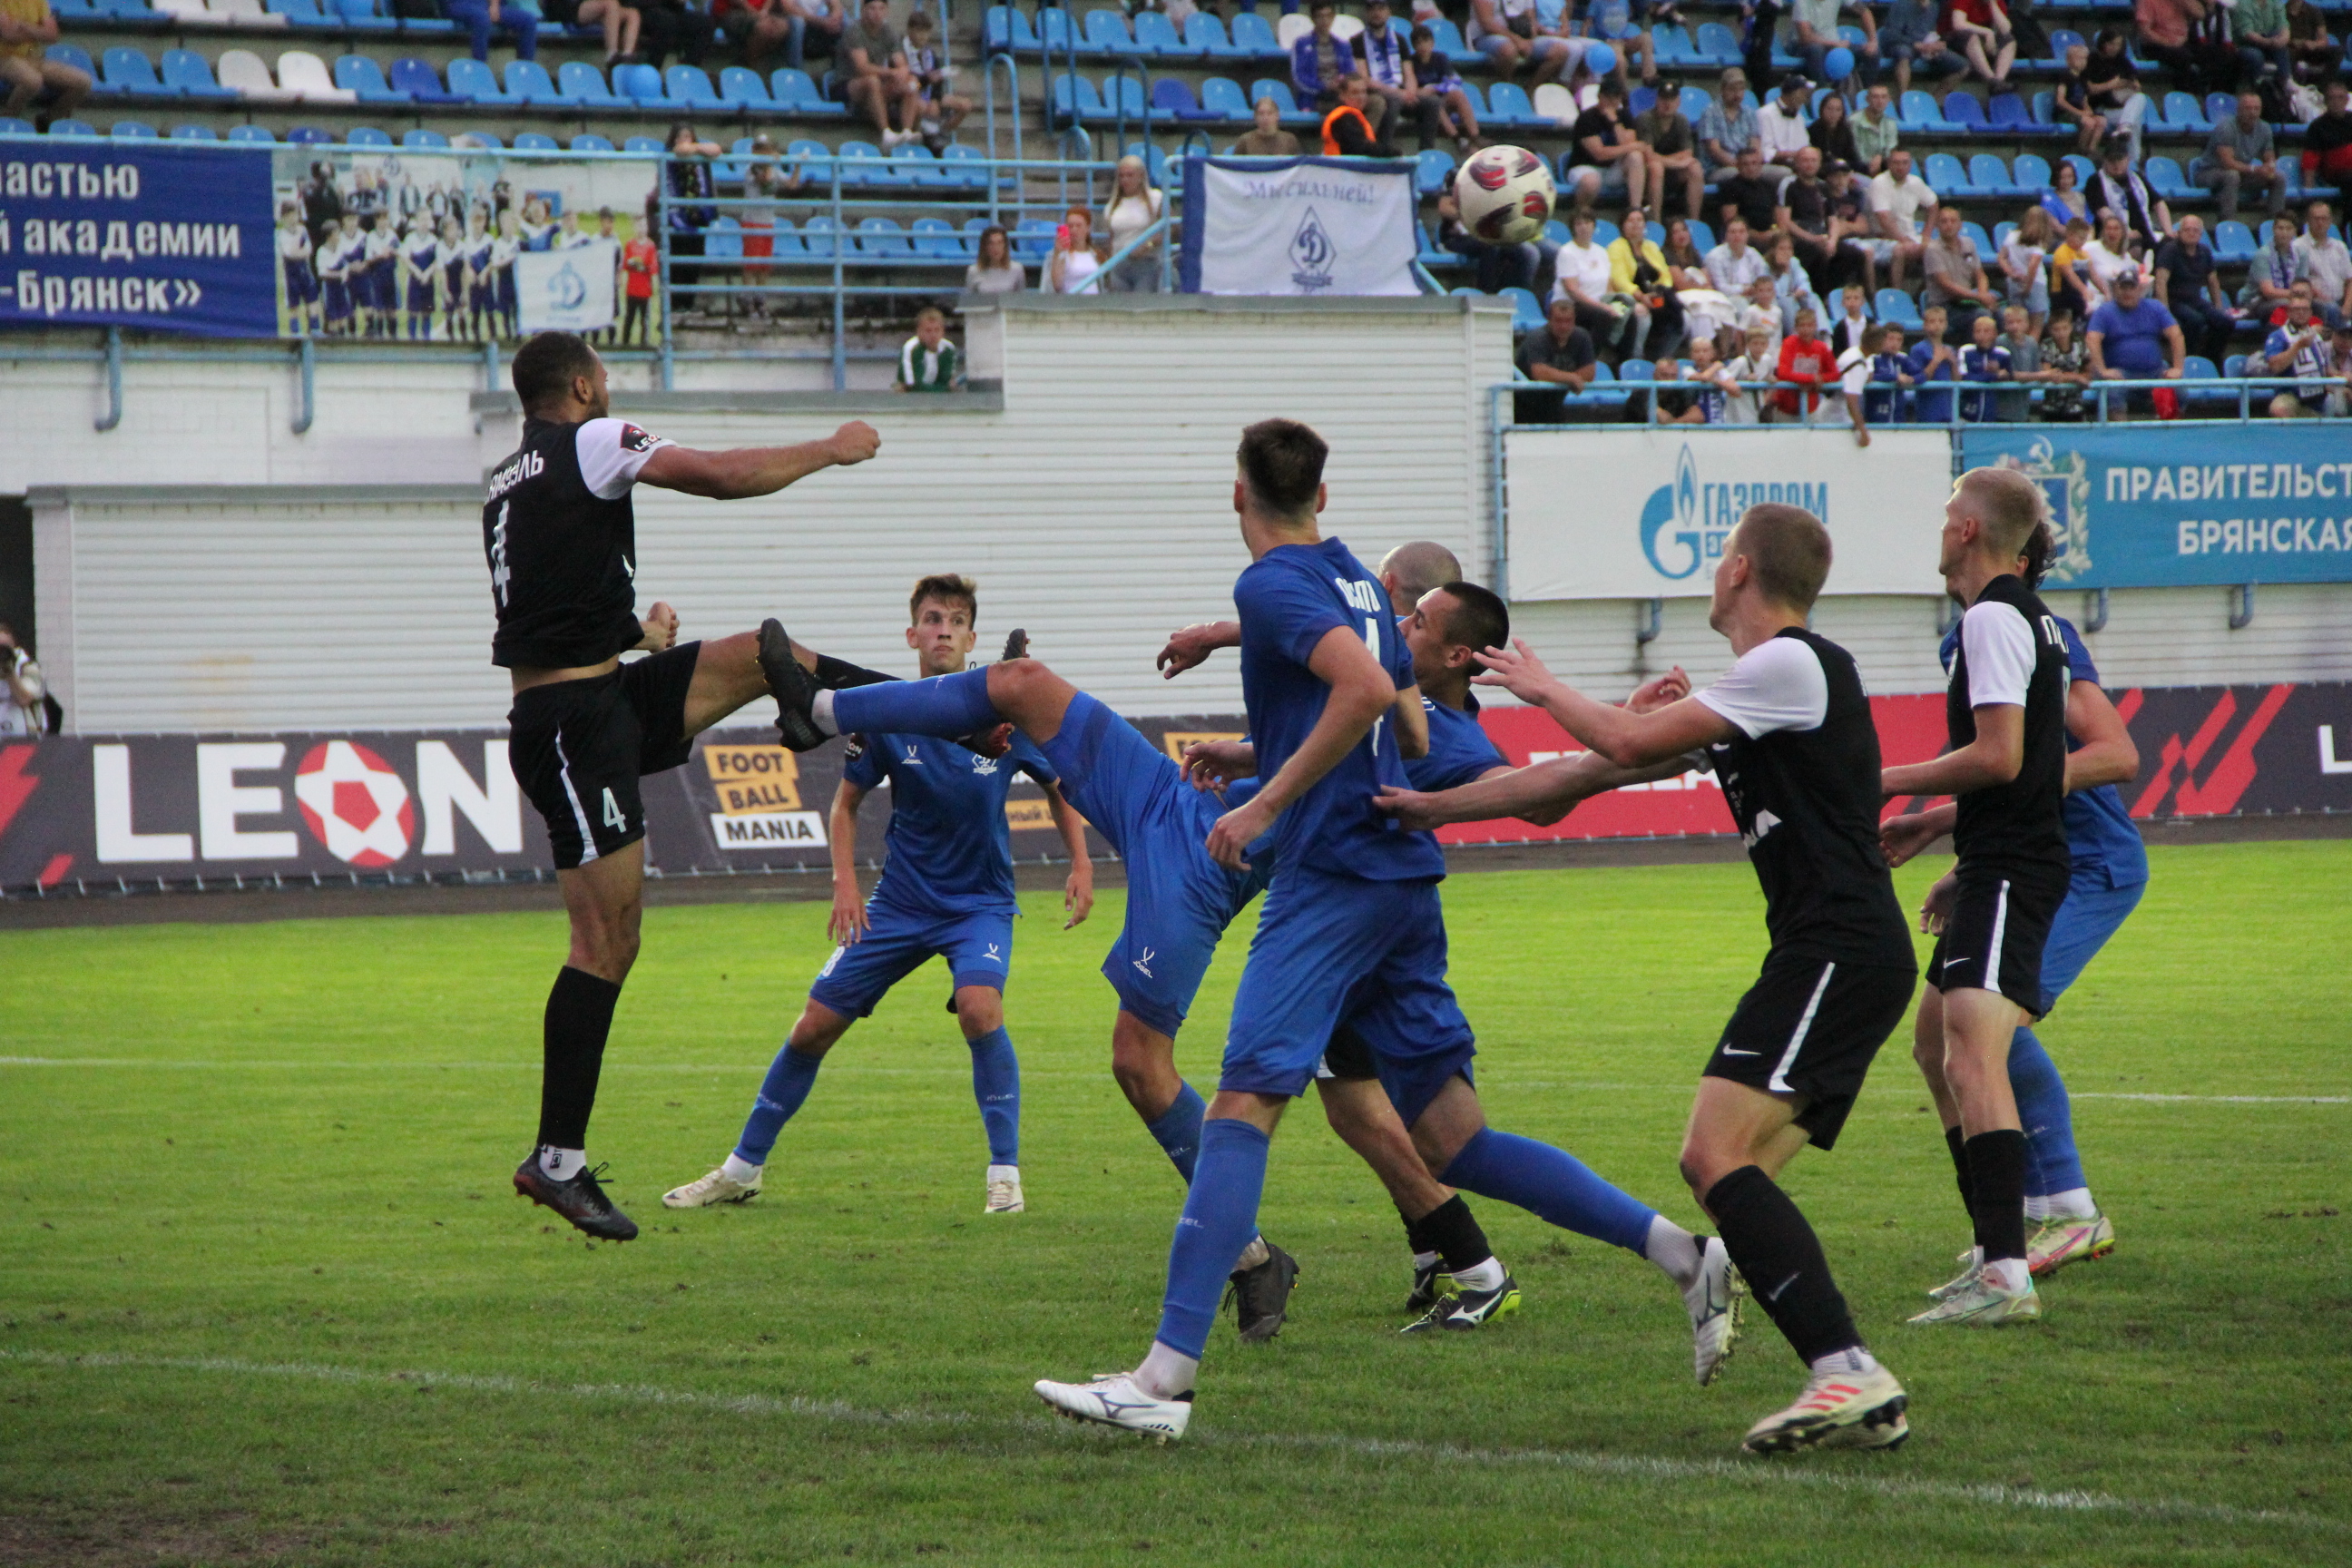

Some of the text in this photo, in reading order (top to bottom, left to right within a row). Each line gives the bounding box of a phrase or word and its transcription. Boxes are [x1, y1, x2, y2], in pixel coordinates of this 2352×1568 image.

[0, 162, 139, 199] астью
[24, 219, 240, 262] академии
[634, 435, 662, 451] LEO
[485, 449, 544, 502] АМУЭЛЬ
[2106, 463, 2352, 501] ПРАВИТЕЛЬСТ
[716, 752, 782, 772] FOOT
[93, 740, 524, 867] LEON
[603, 786, 626, 833] 4
[728, 784, 789, 809] BALL
[724, 819, 815, 841] MANIA
